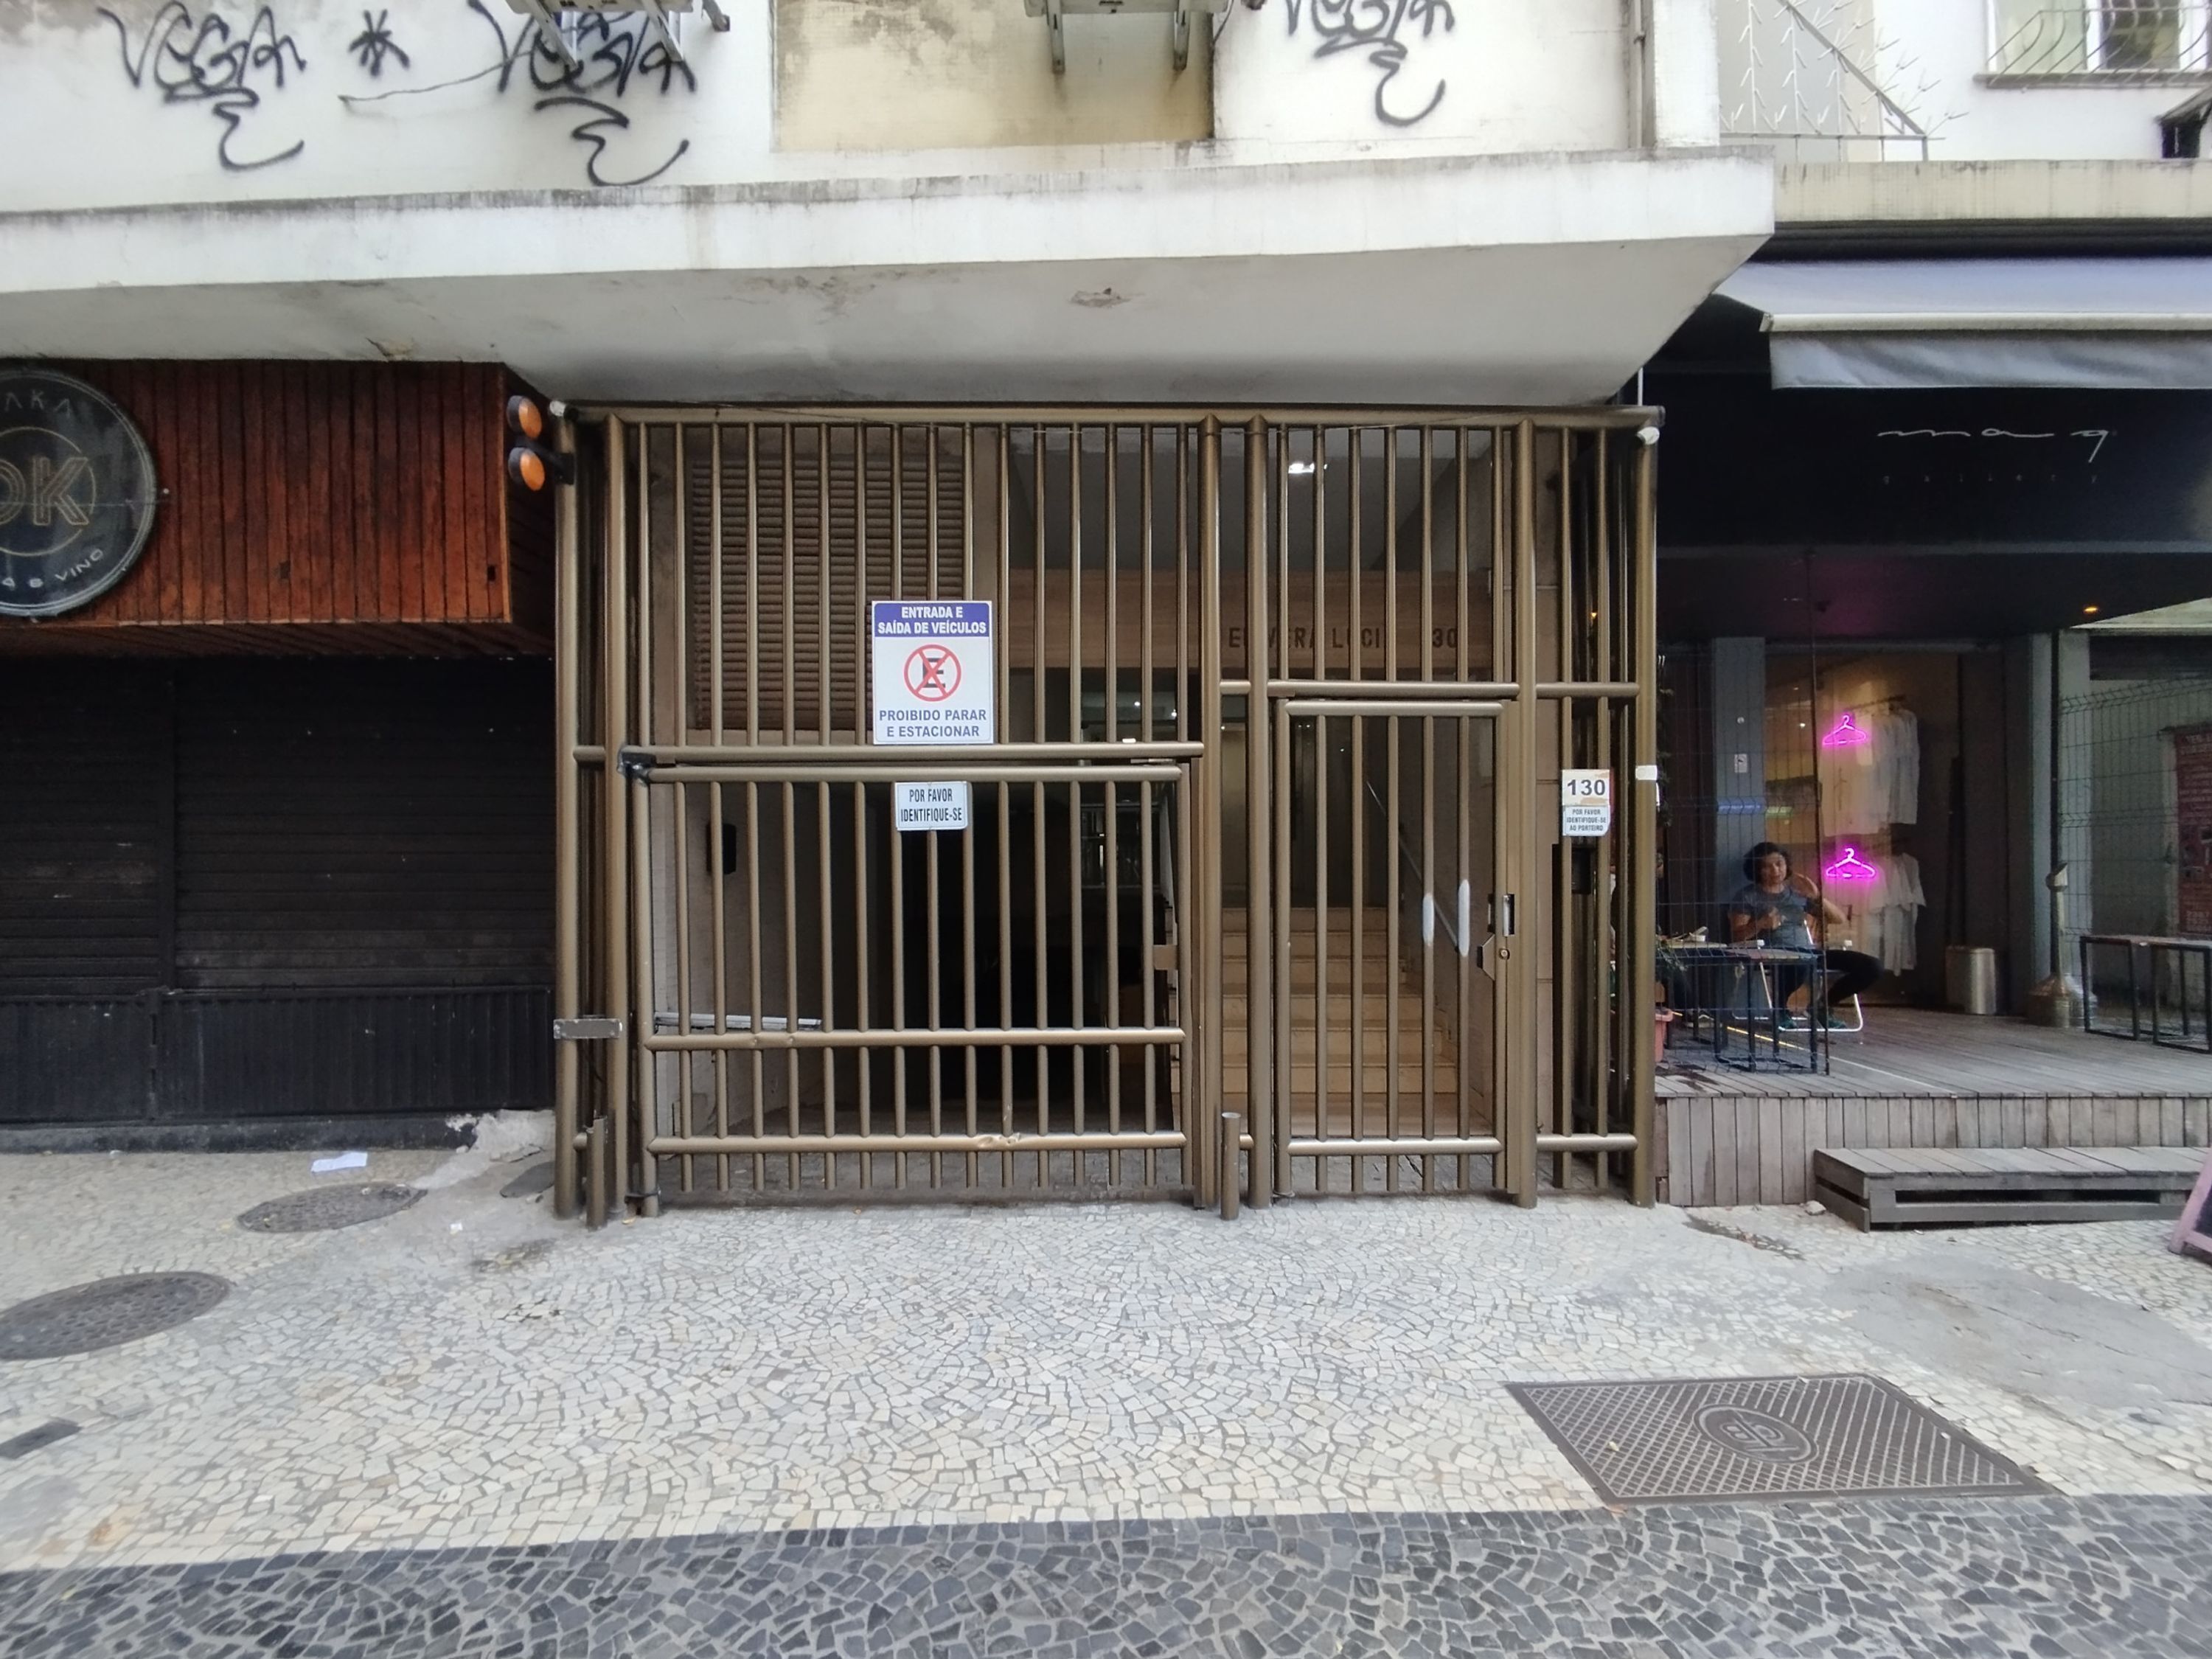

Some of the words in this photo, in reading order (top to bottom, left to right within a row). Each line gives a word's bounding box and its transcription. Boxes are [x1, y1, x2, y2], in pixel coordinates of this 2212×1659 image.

[55, 549, 103, 581] VINO
[901, 606, 953, 619] ENTRADA
[956, 606, 963, 618] E
[877, 619, 911, 634] SAÍDA
[914, 622, 929, 633] DE
[931, 619, 987, 633] VEÍCULOS
[879, 710, 941, 721] PROIBIDO
[945, 709, 987, 720] PARAR
[887, 726, 894, 737] E
[899, 726, 980, 737] ESTACIONAR
[1568, 779, 1606, 796] 130
[909, 789, 925, 803] POR
[928, 788, 953, 802] FAVOR
[901, 807, 962, 822] IDENTIFIQUE-SE
